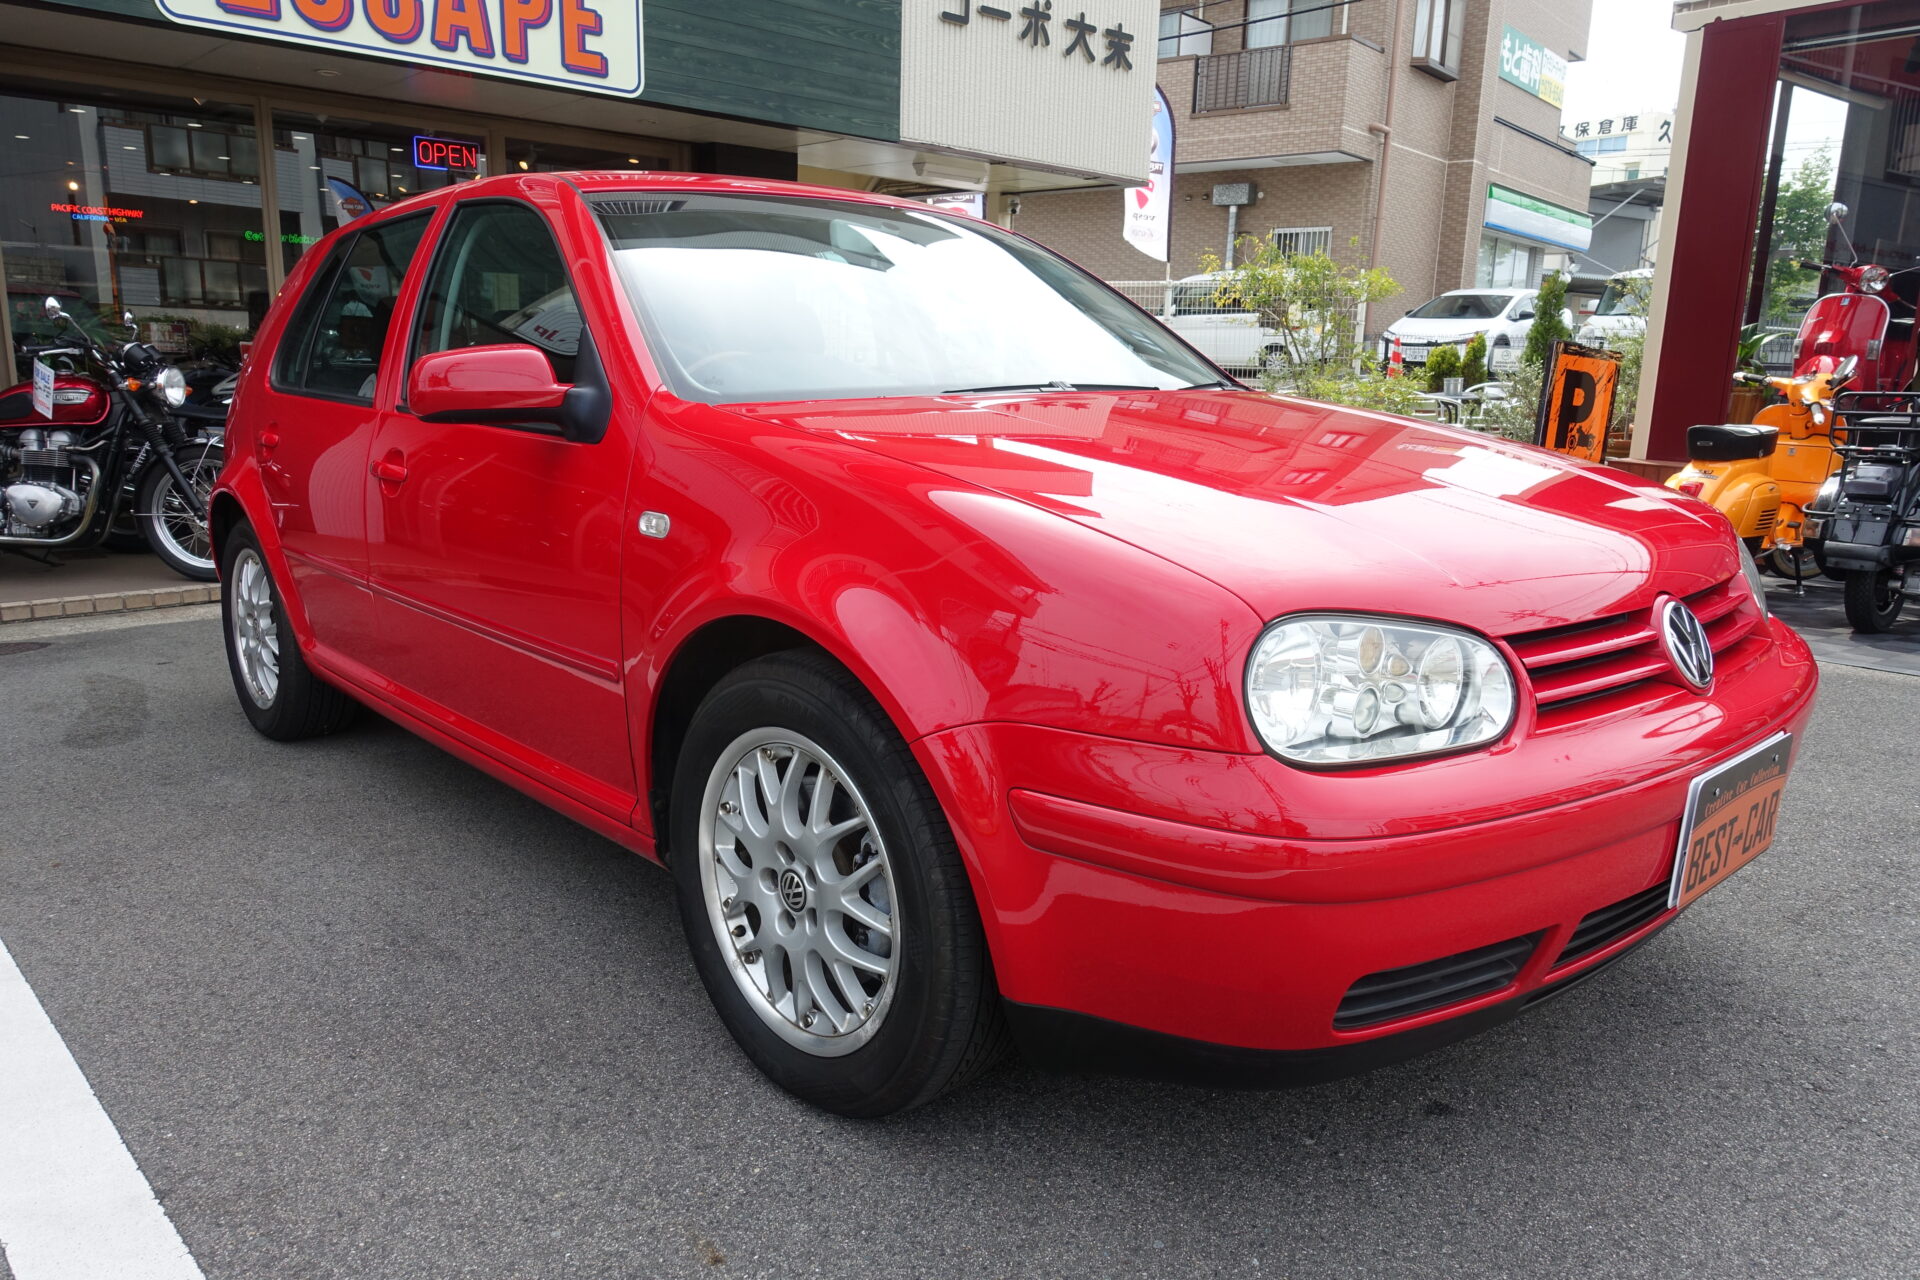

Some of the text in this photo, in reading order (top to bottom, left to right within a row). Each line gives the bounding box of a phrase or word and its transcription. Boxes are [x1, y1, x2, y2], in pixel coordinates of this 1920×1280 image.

[216, 0, 608, 78] APE
[1500, 32, 1542, 90] もと歯科
[419, 141, 476, 168] OPEN
[50, 203, 144, 218] PACIFIC COAST HIGHWAY
[1553, 368, 1597, 449] P
[1685, 789, 1781, 893] BEST-CAR
